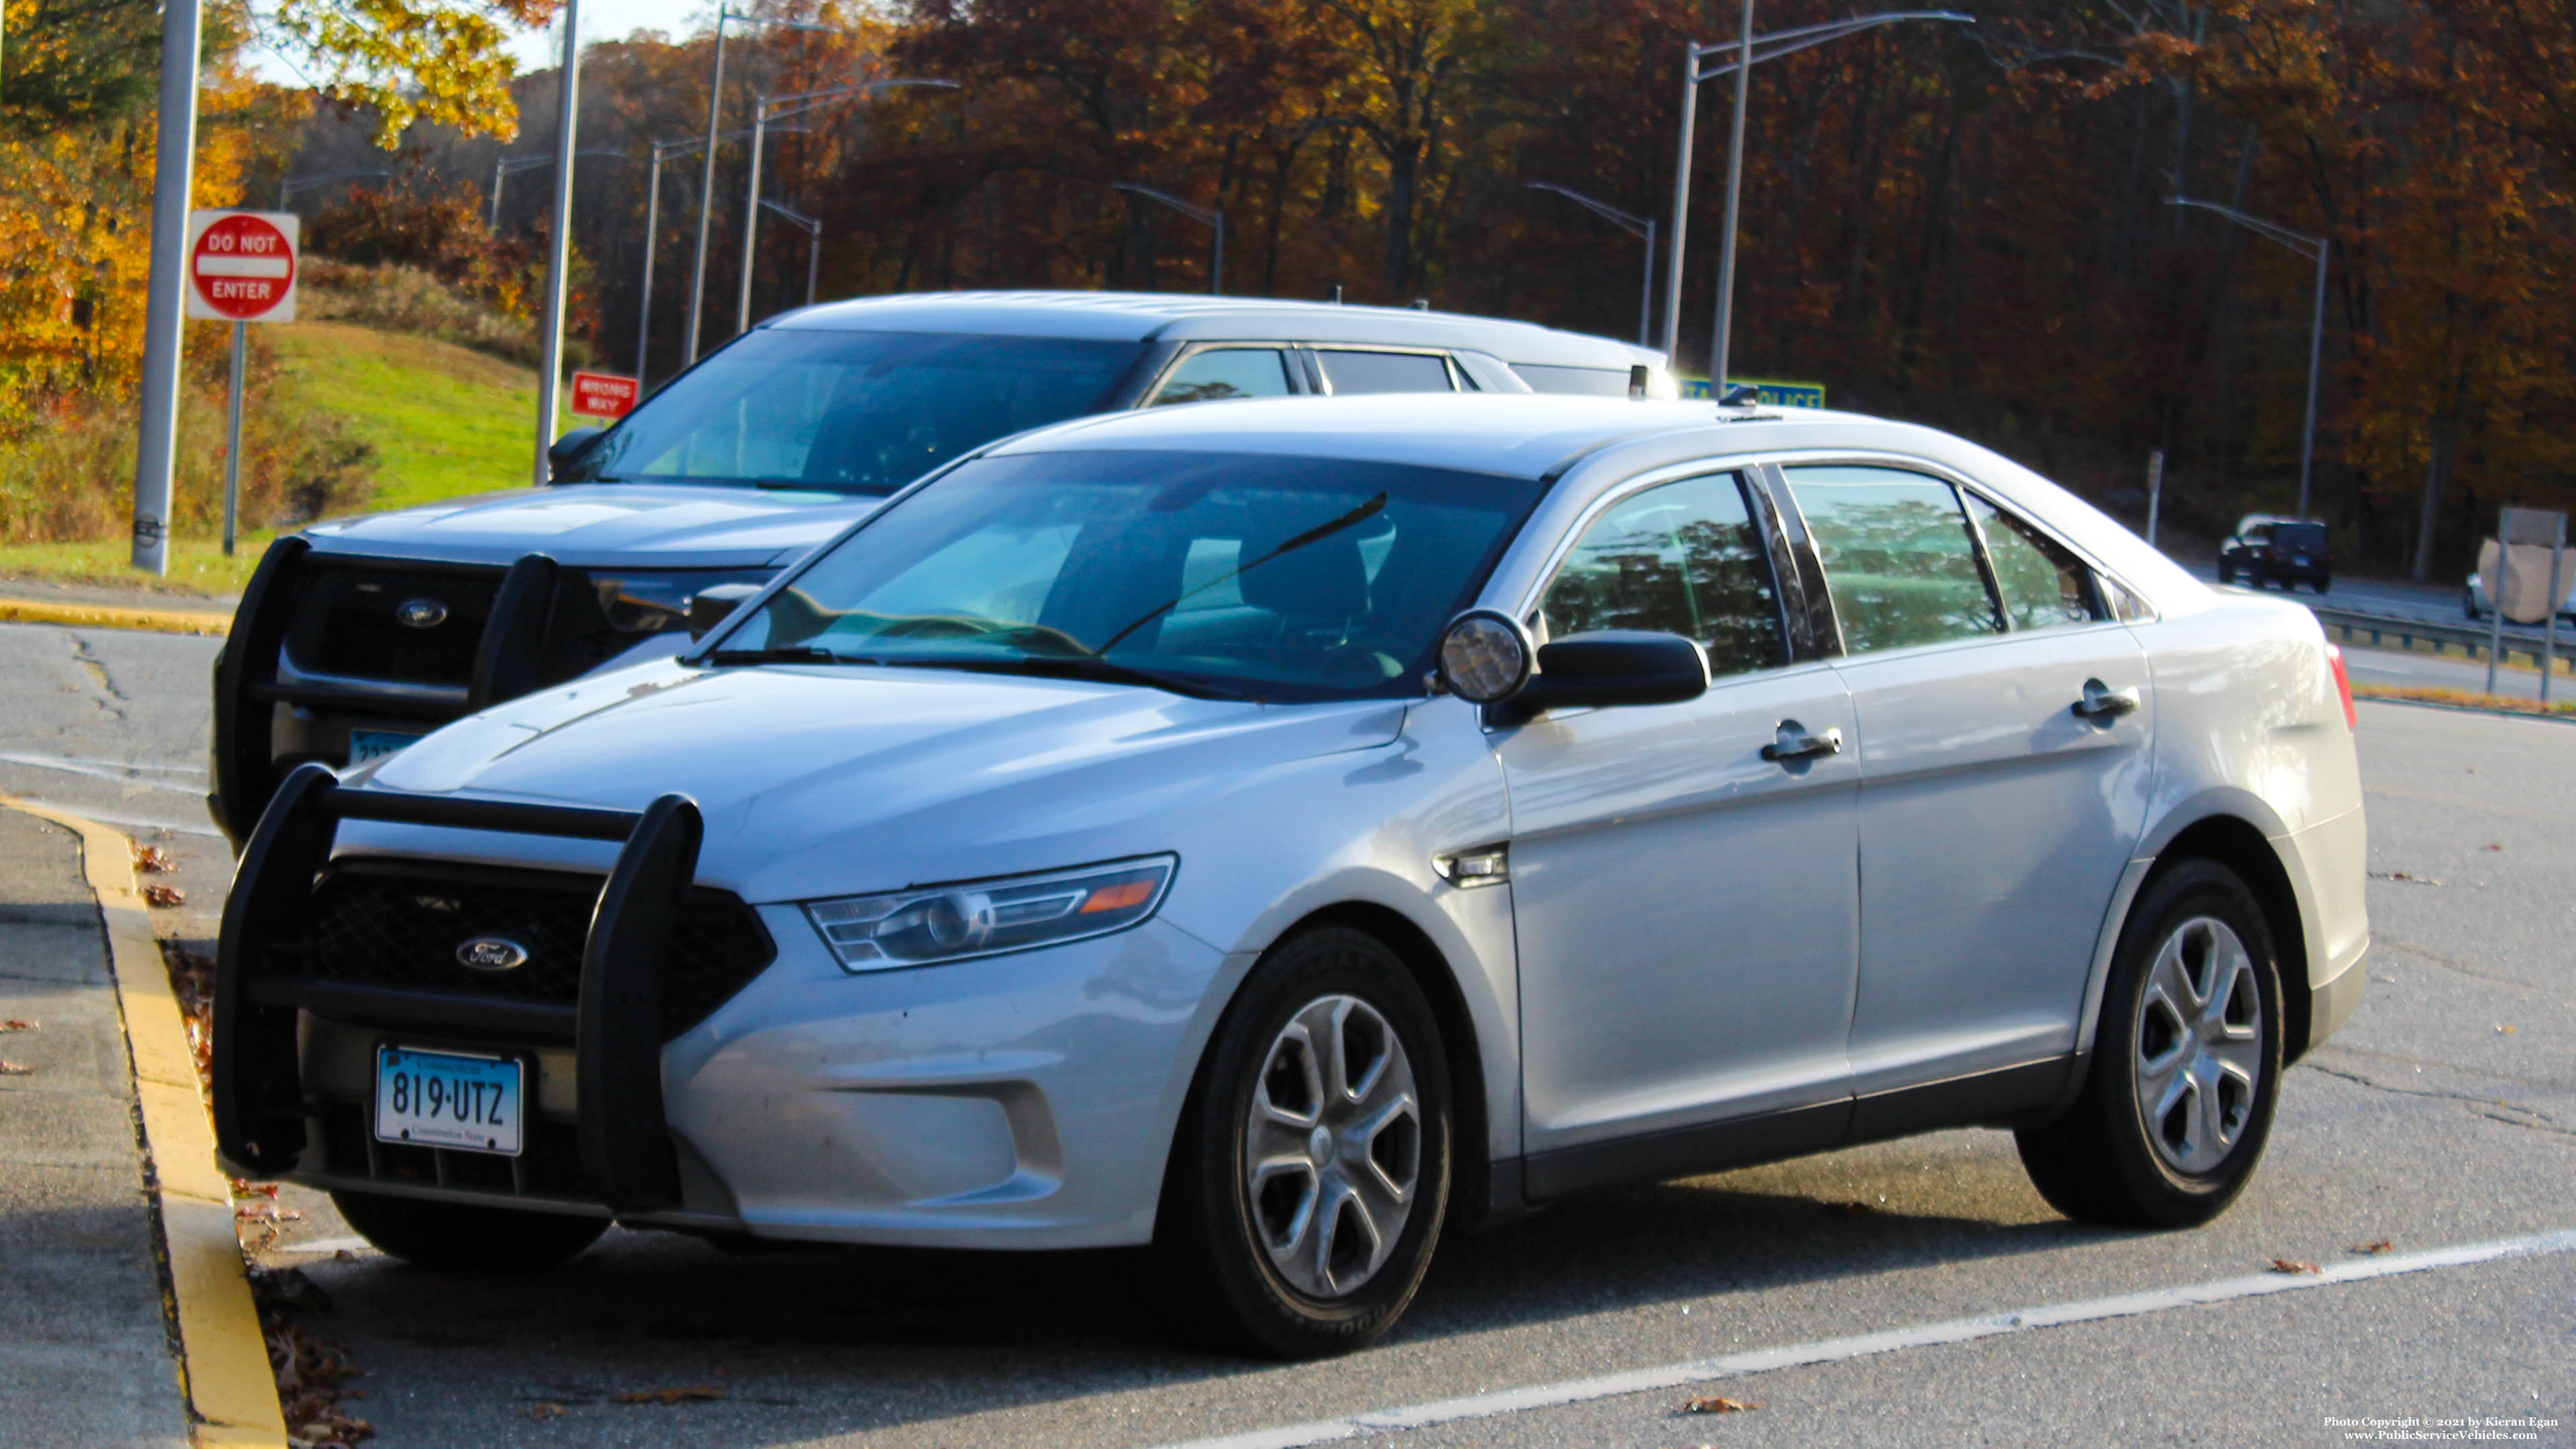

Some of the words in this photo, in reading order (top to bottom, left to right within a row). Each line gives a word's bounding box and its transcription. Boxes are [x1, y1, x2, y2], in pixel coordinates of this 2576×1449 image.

[208, 234, 234, 251] DO
[240, 236, 277, 253] NOT
[212, 281, 271, 299] ENTER
[580, 380, 631, 398] WRONG
[587, 397, 619, 413] WAY
[1759, 390, 1816, 407] OLICE
[470, 943, 508, 965] Ford
[412, 1125, 462, 1139] Constitution
[465, 1129, 485, 1142] State
